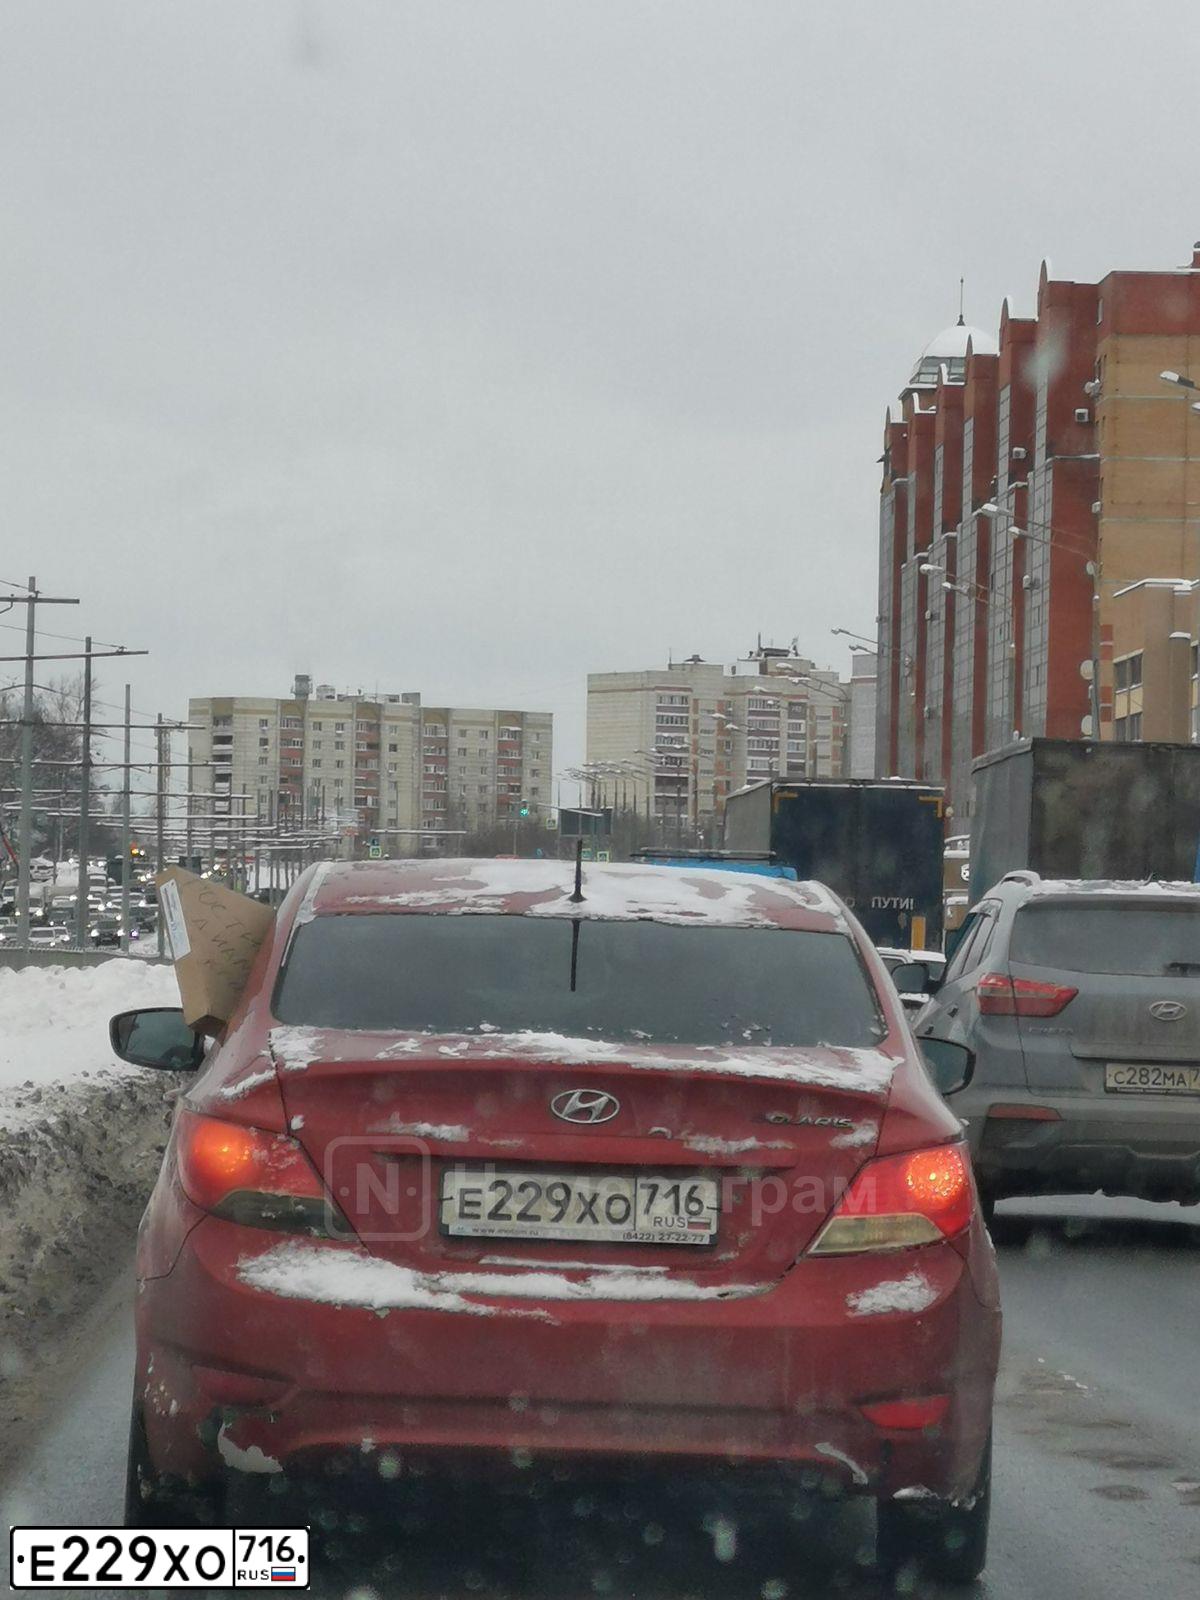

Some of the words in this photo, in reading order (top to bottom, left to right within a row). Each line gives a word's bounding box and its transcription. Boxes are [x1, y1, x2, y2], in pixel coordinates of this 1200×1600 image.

[871, 896, 914, 910] ПУТИ!
[640, 1183, 705, 1217] 716
[653, 1216, 686, 1229] RUS
